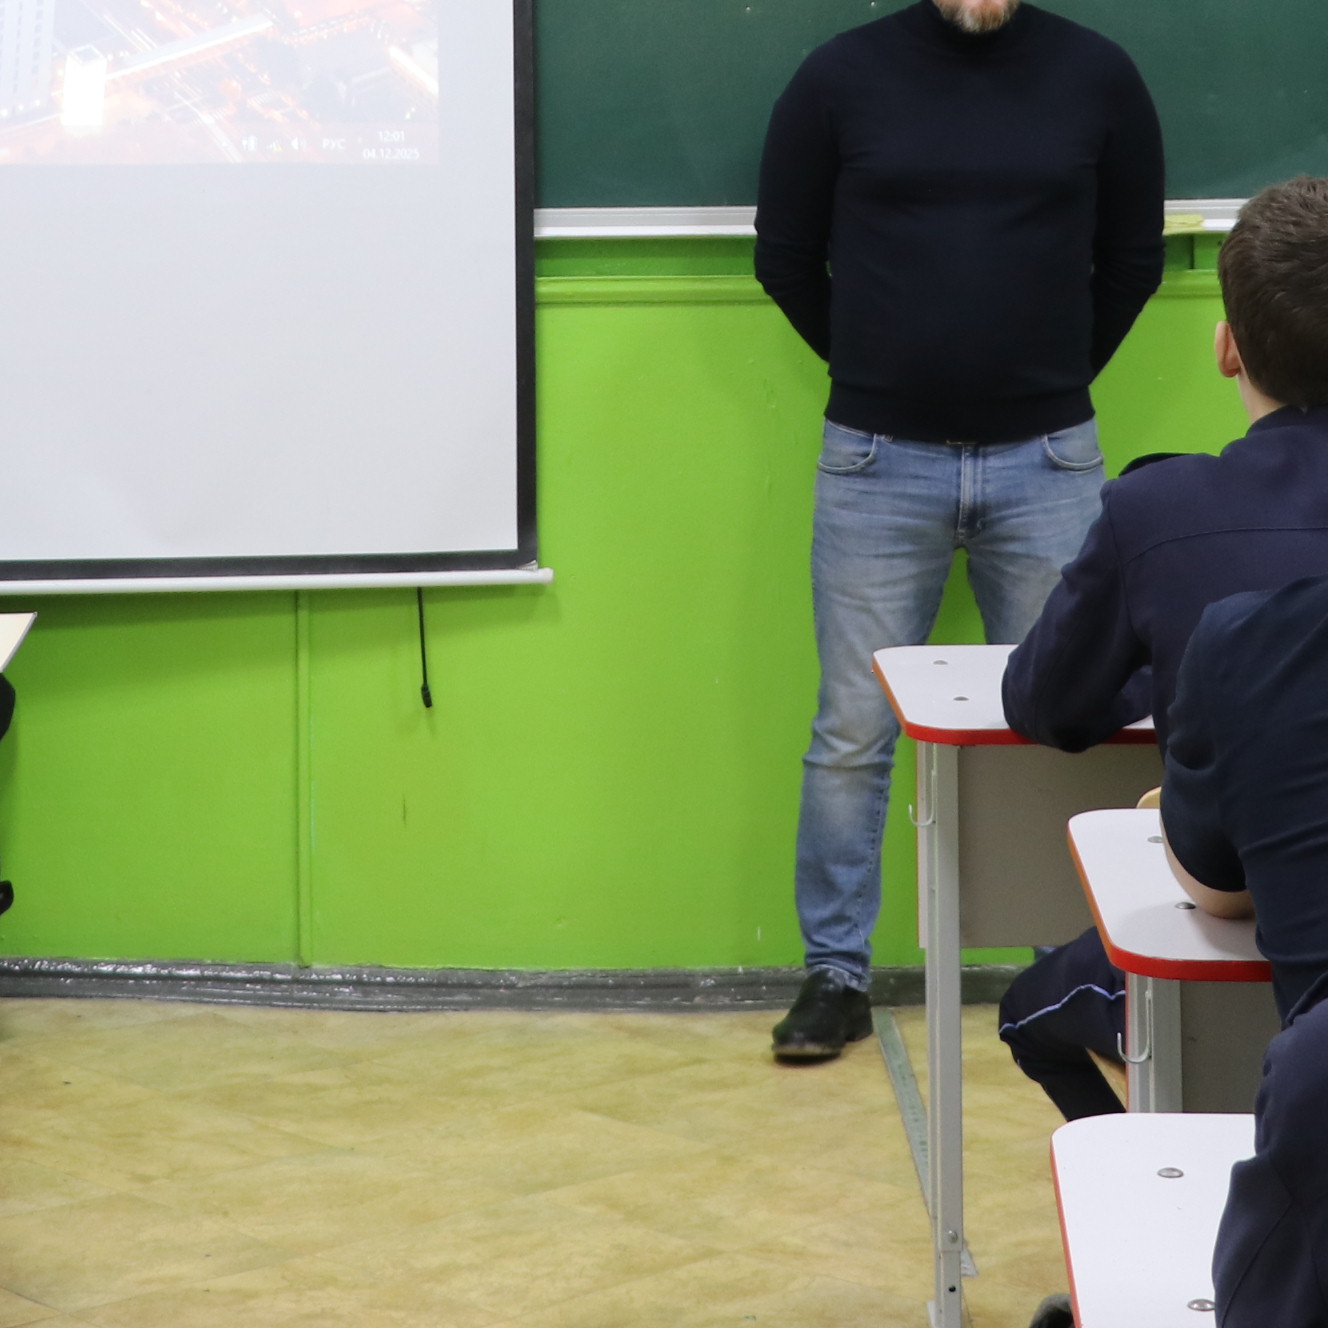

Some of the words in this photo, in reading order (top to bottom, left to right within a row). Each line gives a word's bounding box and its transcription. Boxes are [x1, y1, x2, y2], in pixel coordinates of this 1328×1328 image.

[378, 130, 405, 142] 12:01
[323, 138, 346, 150] РУС
[362, 148, 420, 159] 04.12.2025
